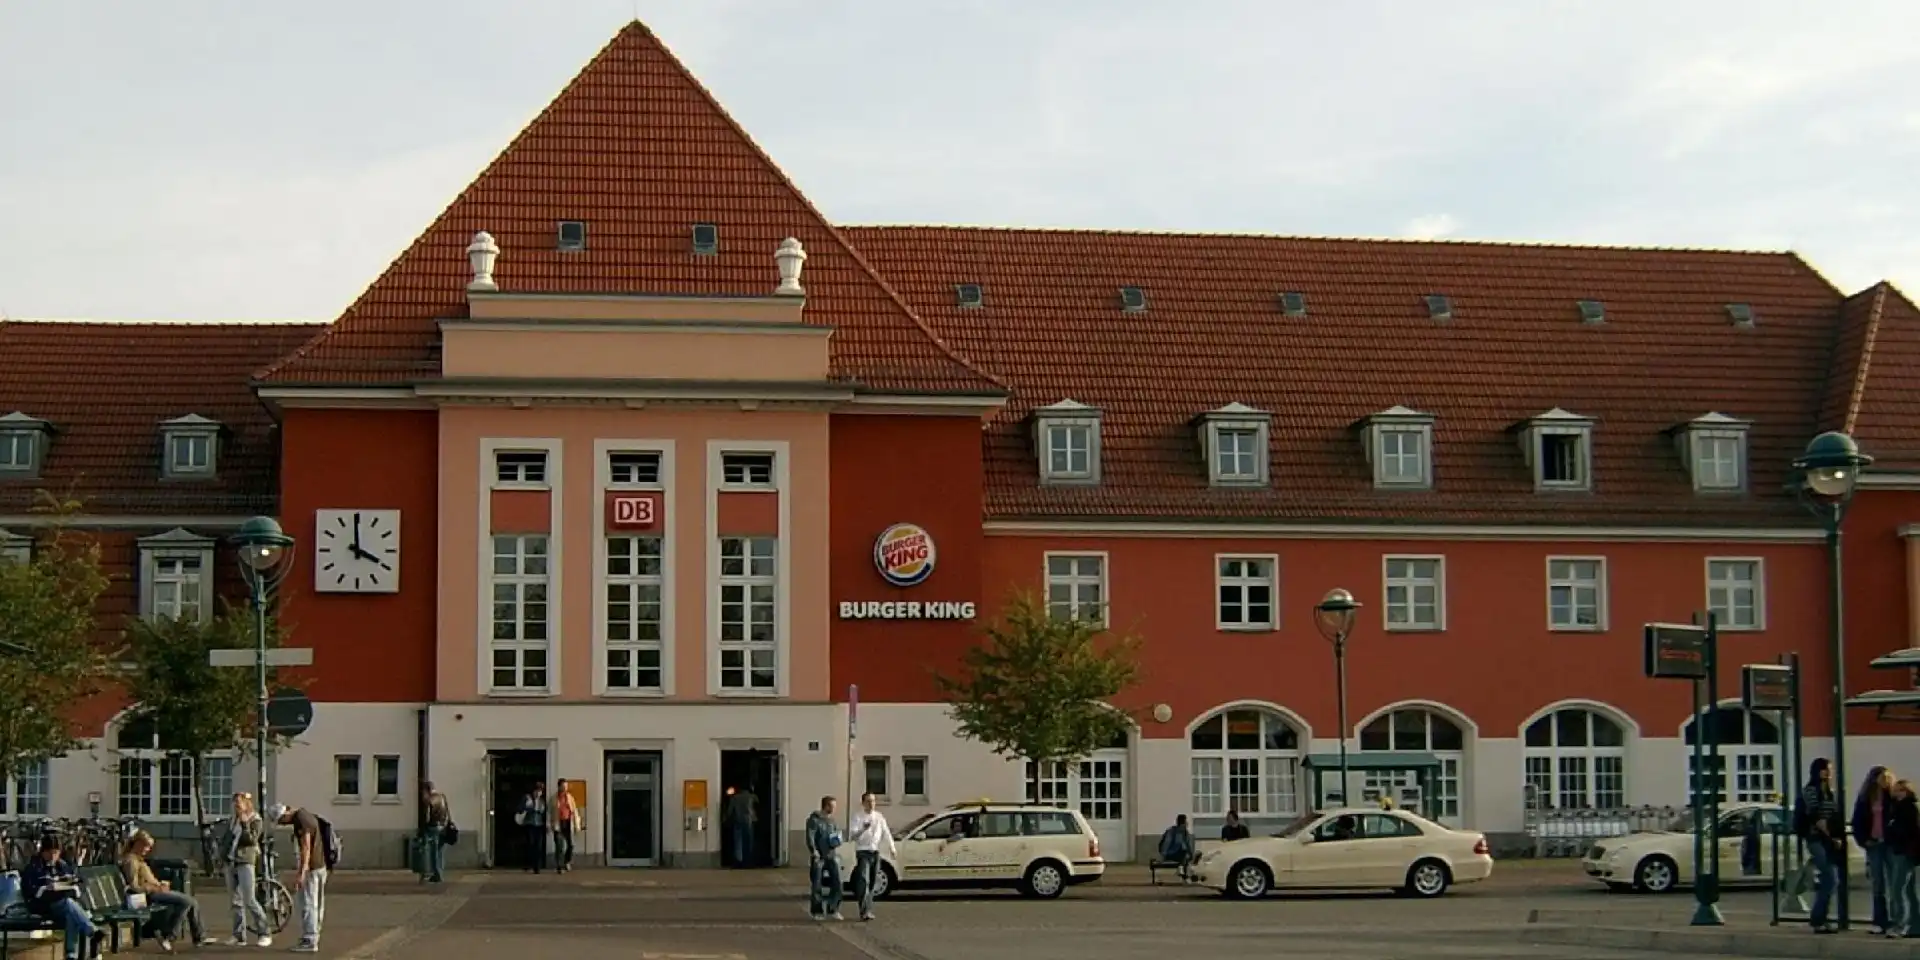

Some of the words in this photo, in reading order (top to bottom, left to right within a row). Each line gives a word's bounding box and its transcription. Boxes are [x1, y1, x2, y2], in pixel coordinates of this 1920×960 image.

[617, 500, 652, 521] DB
[881, 534, 925, 555] BURGER
[885, 546, 928, 569] KING
[840, 601, 921, 618] BURGER
[925, 601, 975, 618] KING
